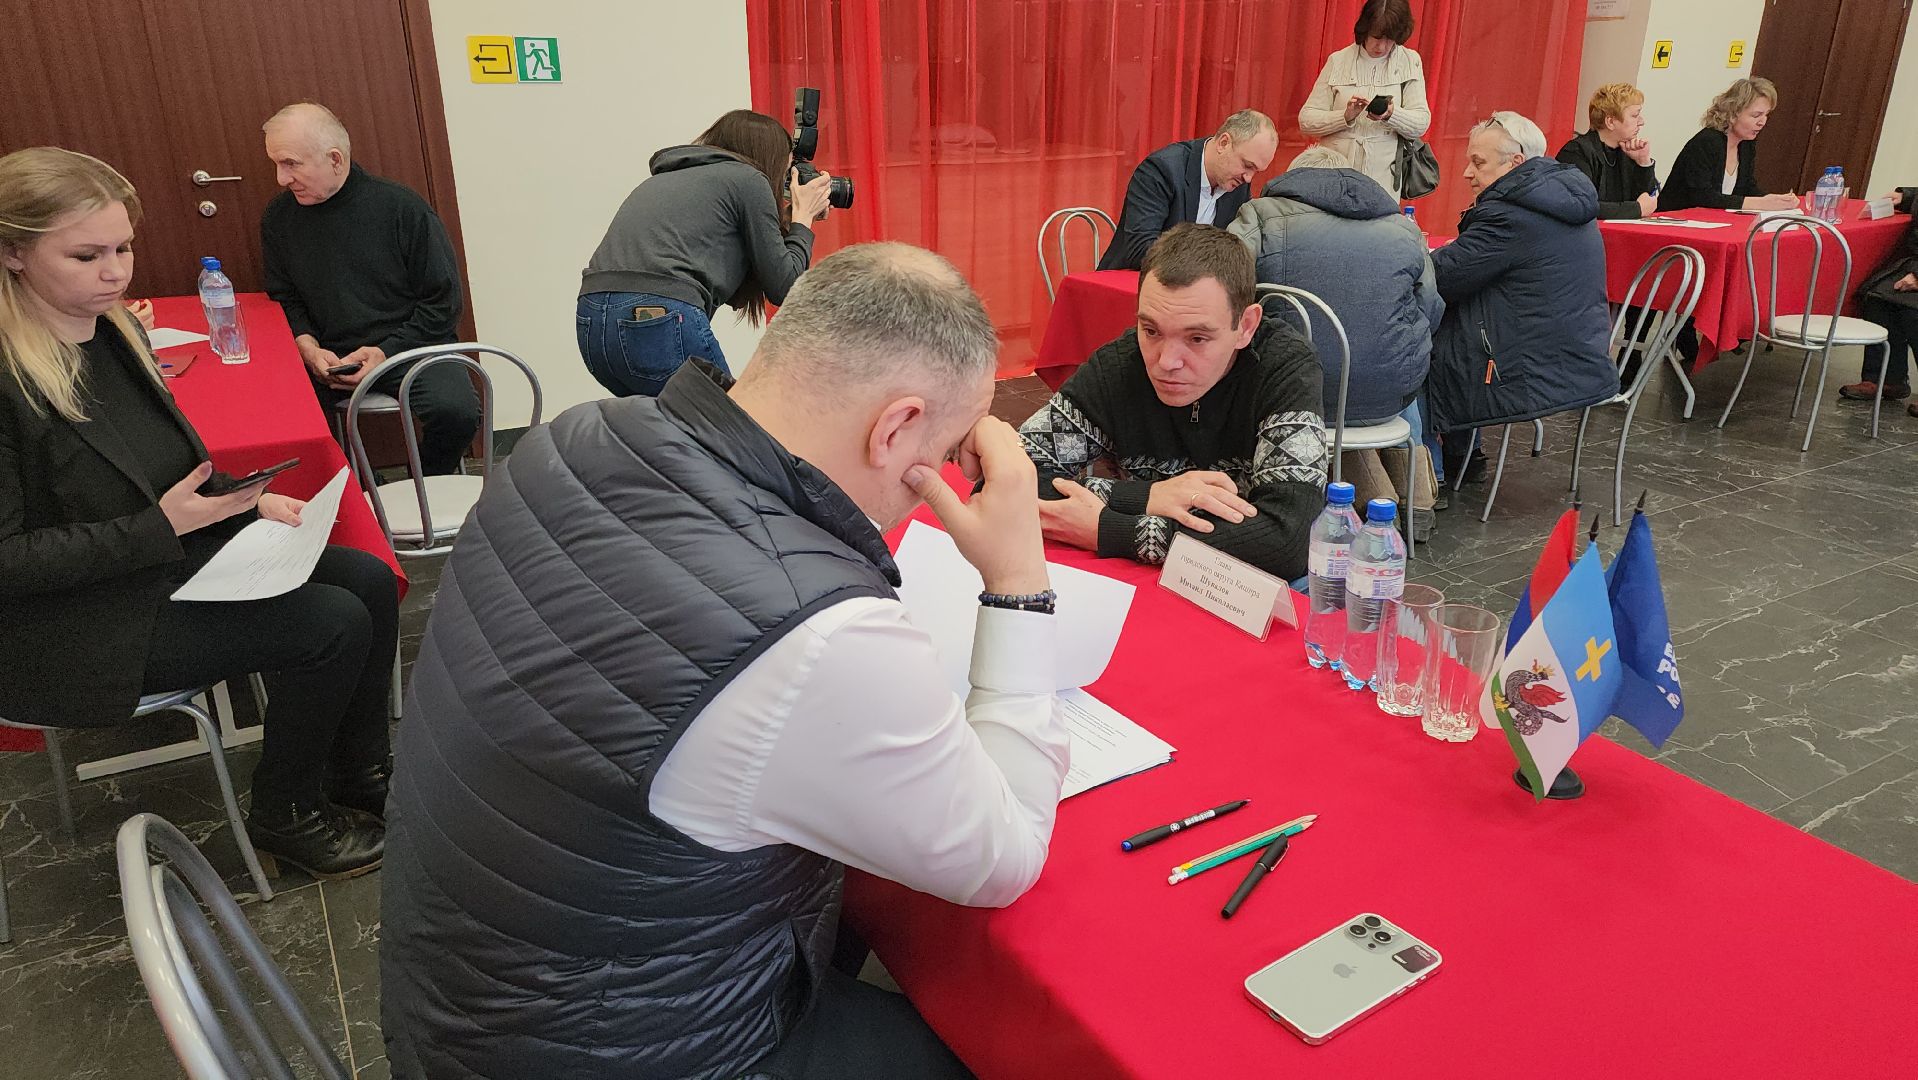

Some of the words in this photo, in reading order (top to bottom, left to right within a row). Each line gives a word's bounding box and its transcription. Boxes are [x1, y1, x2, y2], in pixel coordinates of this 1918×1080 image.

[1180, 554, 1213, 575] городского
[1213, 570, 1234, 585] округа
[1234, 580, 1261, 599] Кашира
[1215, 556, 1232, 571] Глава
[1180, 575, 1203, 595] Михаил
[1205, 590, 1246, 617] Николаевич
[1200, 574, 1230, 596] Шувалов
